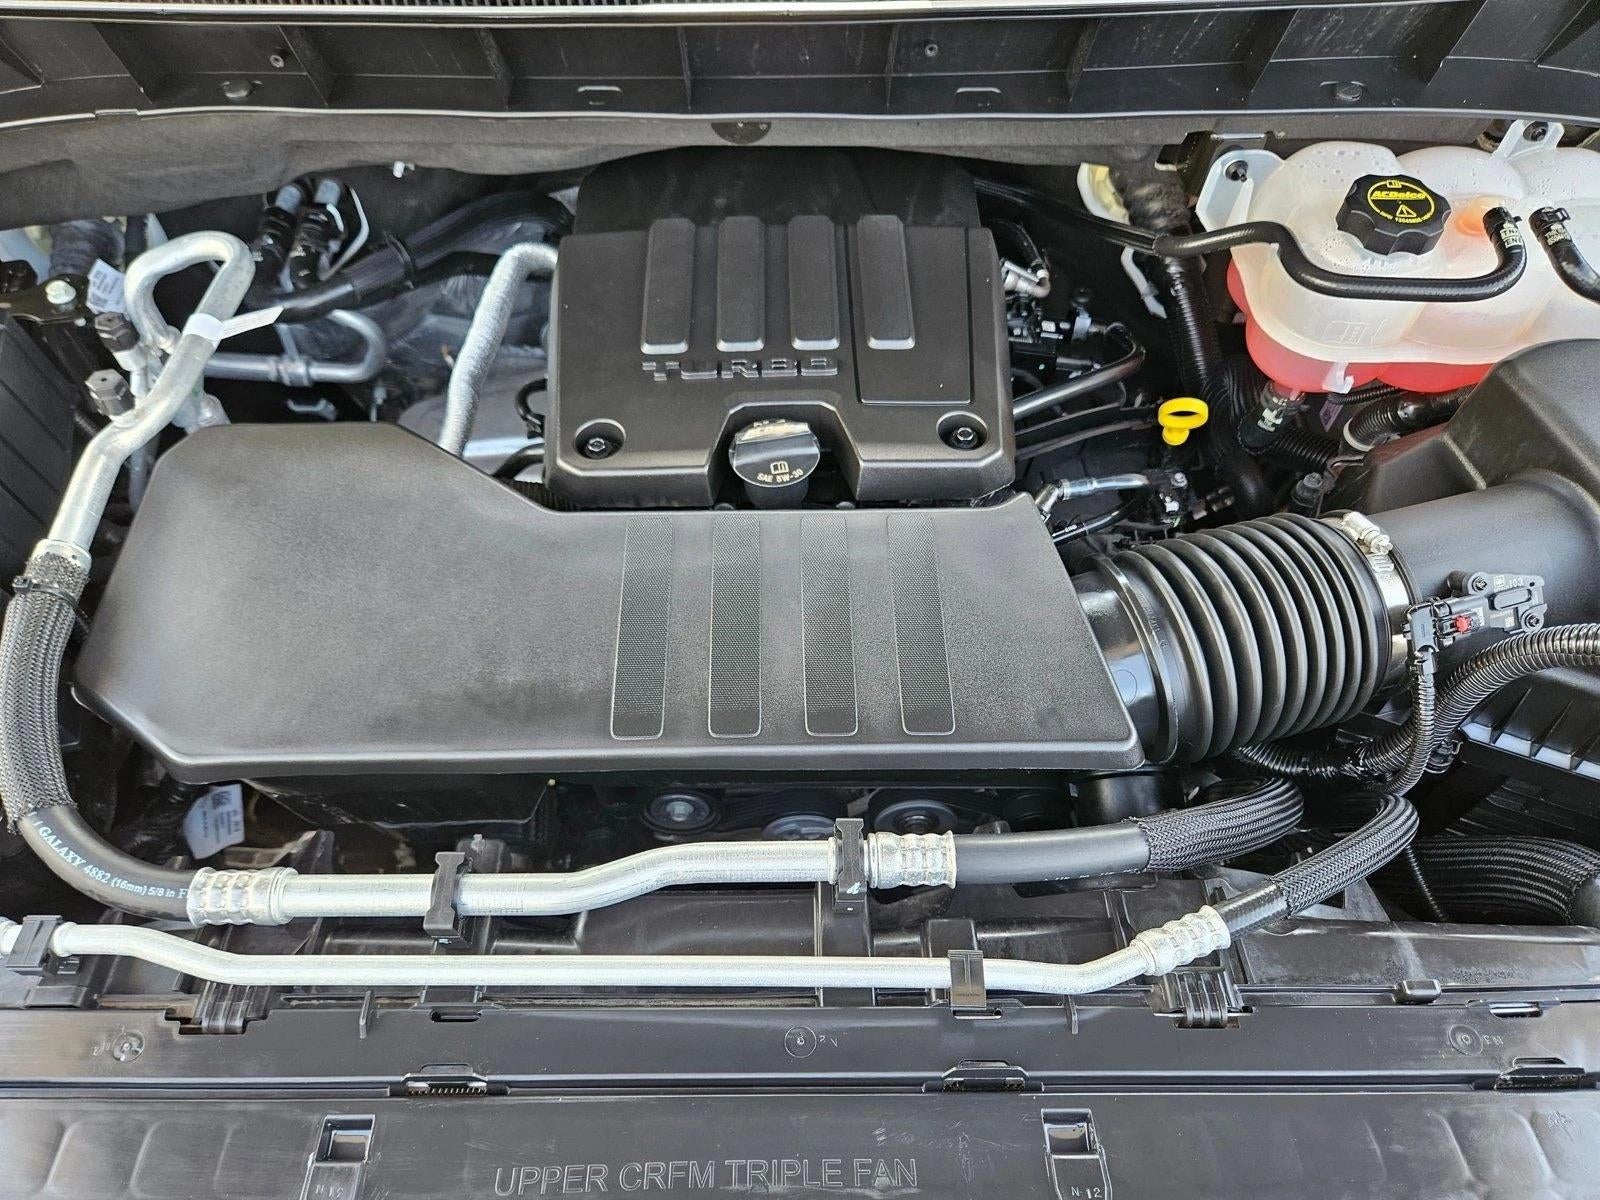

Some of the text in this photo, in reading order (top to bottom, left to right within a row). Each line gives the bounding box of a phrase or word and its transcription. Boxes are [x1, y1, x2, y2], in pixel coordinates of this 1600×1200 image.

[1371, 190, 1426, 200] ACDelco
[642, 357, 838, 381] TURBO
[757, 472, 773, 482] SAE
[38, 826, 86, 868] GALAXY
[84, 864, 110, 883] 4882
[111, 877, 147, 896] (16mm)
[148, 886, 164, 896] 5/8
[494, 1158, 918, 1196] UPPER CRFM TRIPLE FAN
